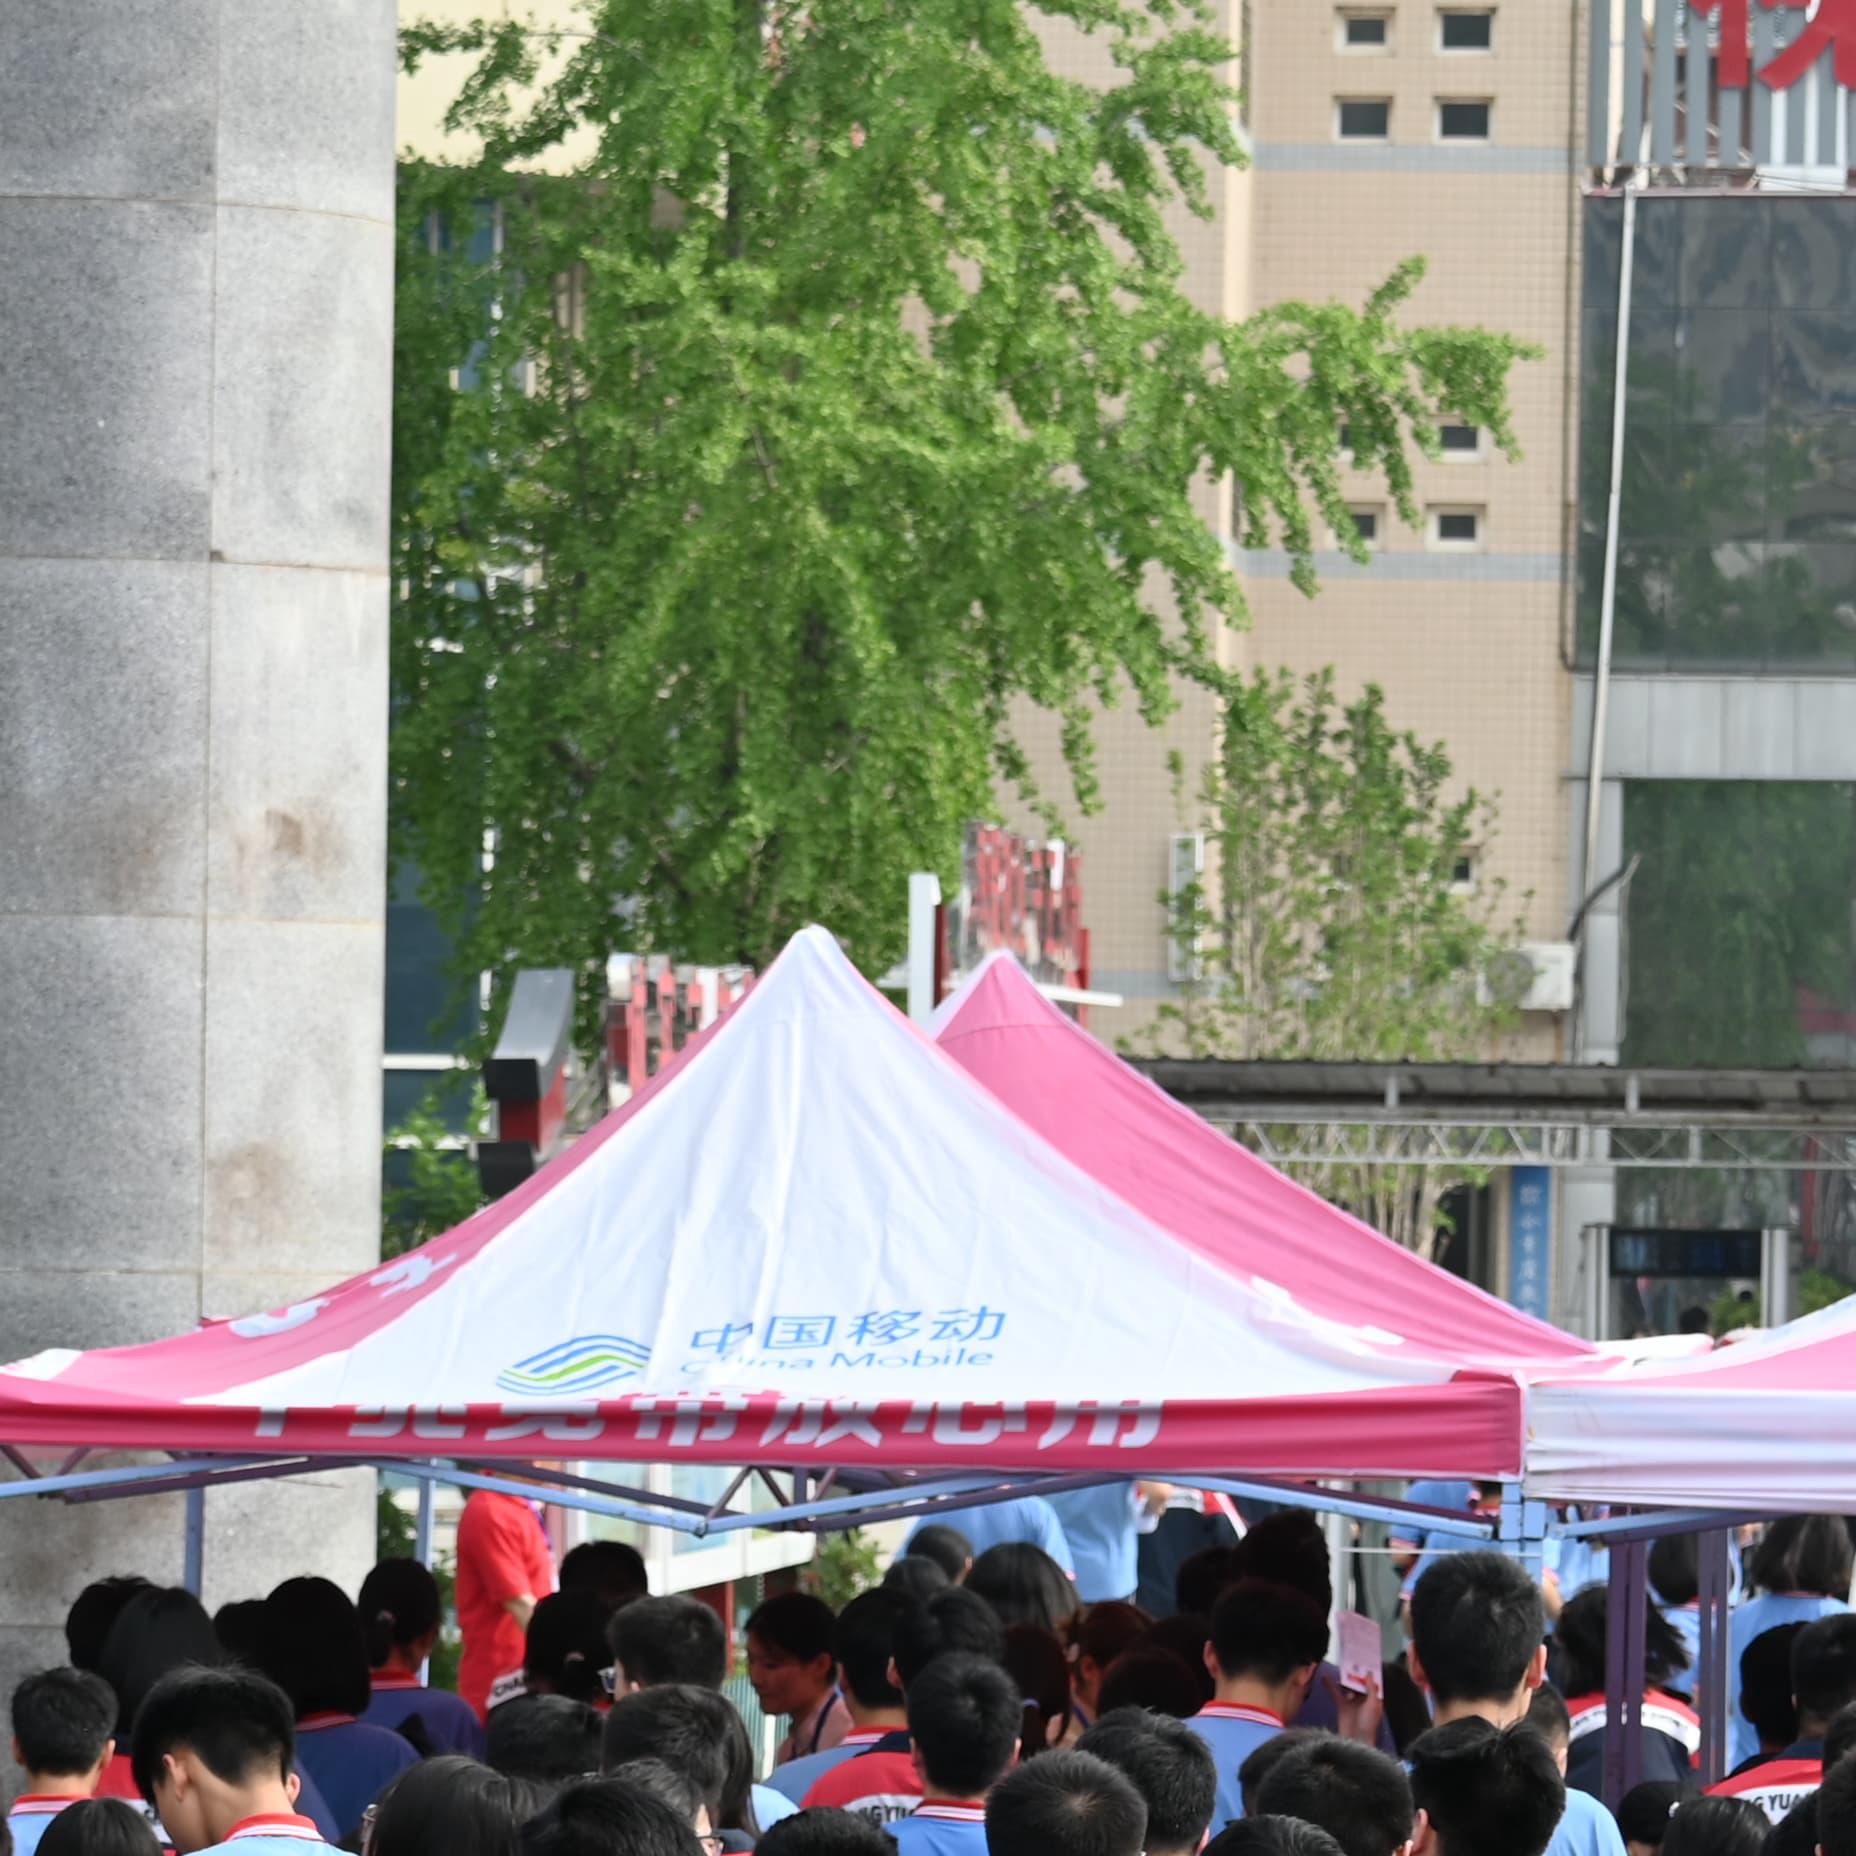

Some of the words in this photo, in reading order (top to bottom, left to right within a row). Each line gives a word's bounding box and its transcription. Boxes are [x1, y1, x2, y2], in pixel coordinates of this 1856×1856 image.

[690, 1305, 1006, 1354] 中国移动
[679, 1350, 815, 1374] Cina
[829, 1347, 994, 1369] Mobile
